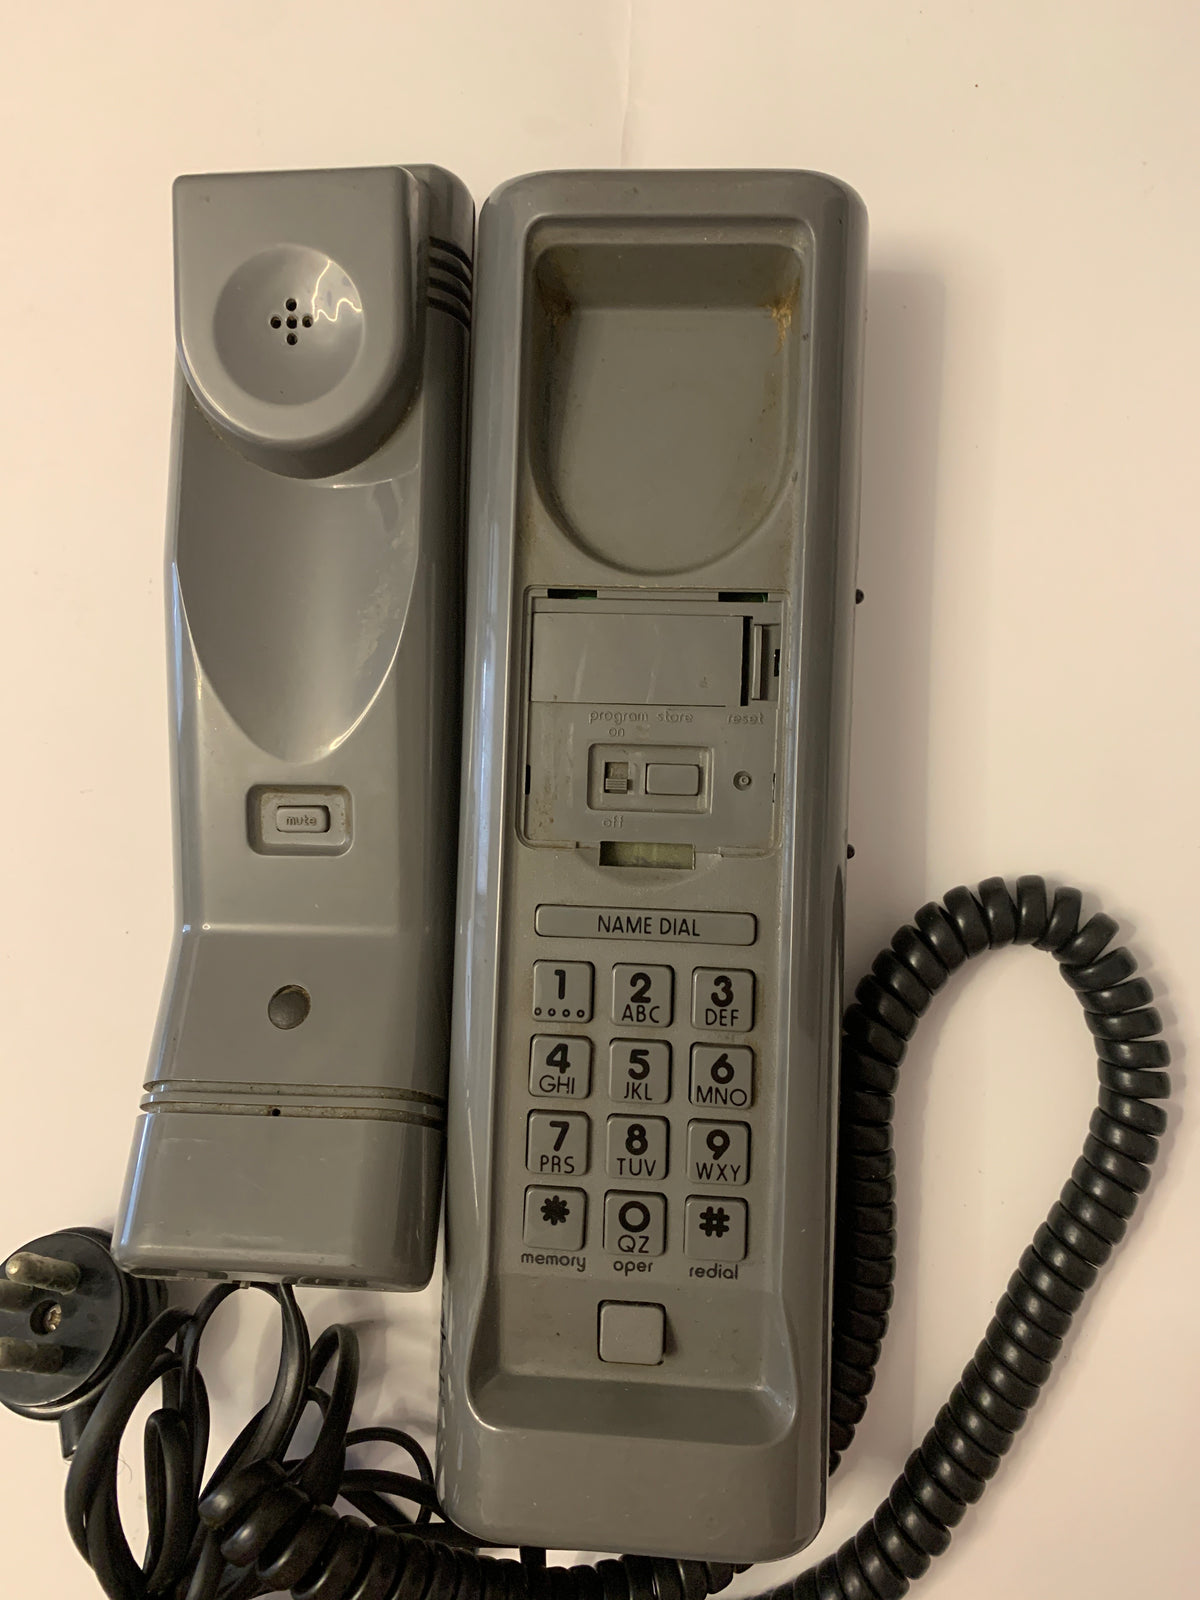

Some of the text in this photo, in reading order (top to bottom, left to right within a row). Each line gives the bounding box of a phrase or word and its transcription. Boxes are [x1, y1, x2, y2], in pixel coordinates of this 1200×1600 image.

[589, 710, 693, 724] program store
[727, 711, 763, 724] reset
[608, 726, 625, 737] on
[286, 815, 317, 826] mute
[602, 815, 624, 829] off
[597, 914, 700, 936] NAME DIAL
[553, 969, 567, 1000] 1
[629, 972, 652, 1004] 2
[710, 975, 734, 1007] 3
[621, 1004, 660, 1023] ABC
[705, 1008, 739, 1026] DEF
[545, 1043, 571, 1074] 4
[627, 1049, 650, 1080] 5
[710, 1053, 735, 1084] 6
[539, 1075, 575, 1094] GHI
[624, 1082, 652, 1100] JKL
[696, 1086, 747, 1106] MNO
[549, 1121, 570, 1152] 7
[625, 1123, 648, 1155] 8
[706, 1129, 730, 1160] 9
[539, 1155, 575, 1174] PRS
[617, 1158, 656, 1176] TUV
[696, 1162, 741, 1181] WXY
[699, 1206, 730, 1238] #
[617, 1235, 650, 1253] QZ
[521, 1252, 586, 1272] memory
[613, 1259, 653, 1276] oper
[689, 1263, 739, 1280] redial
